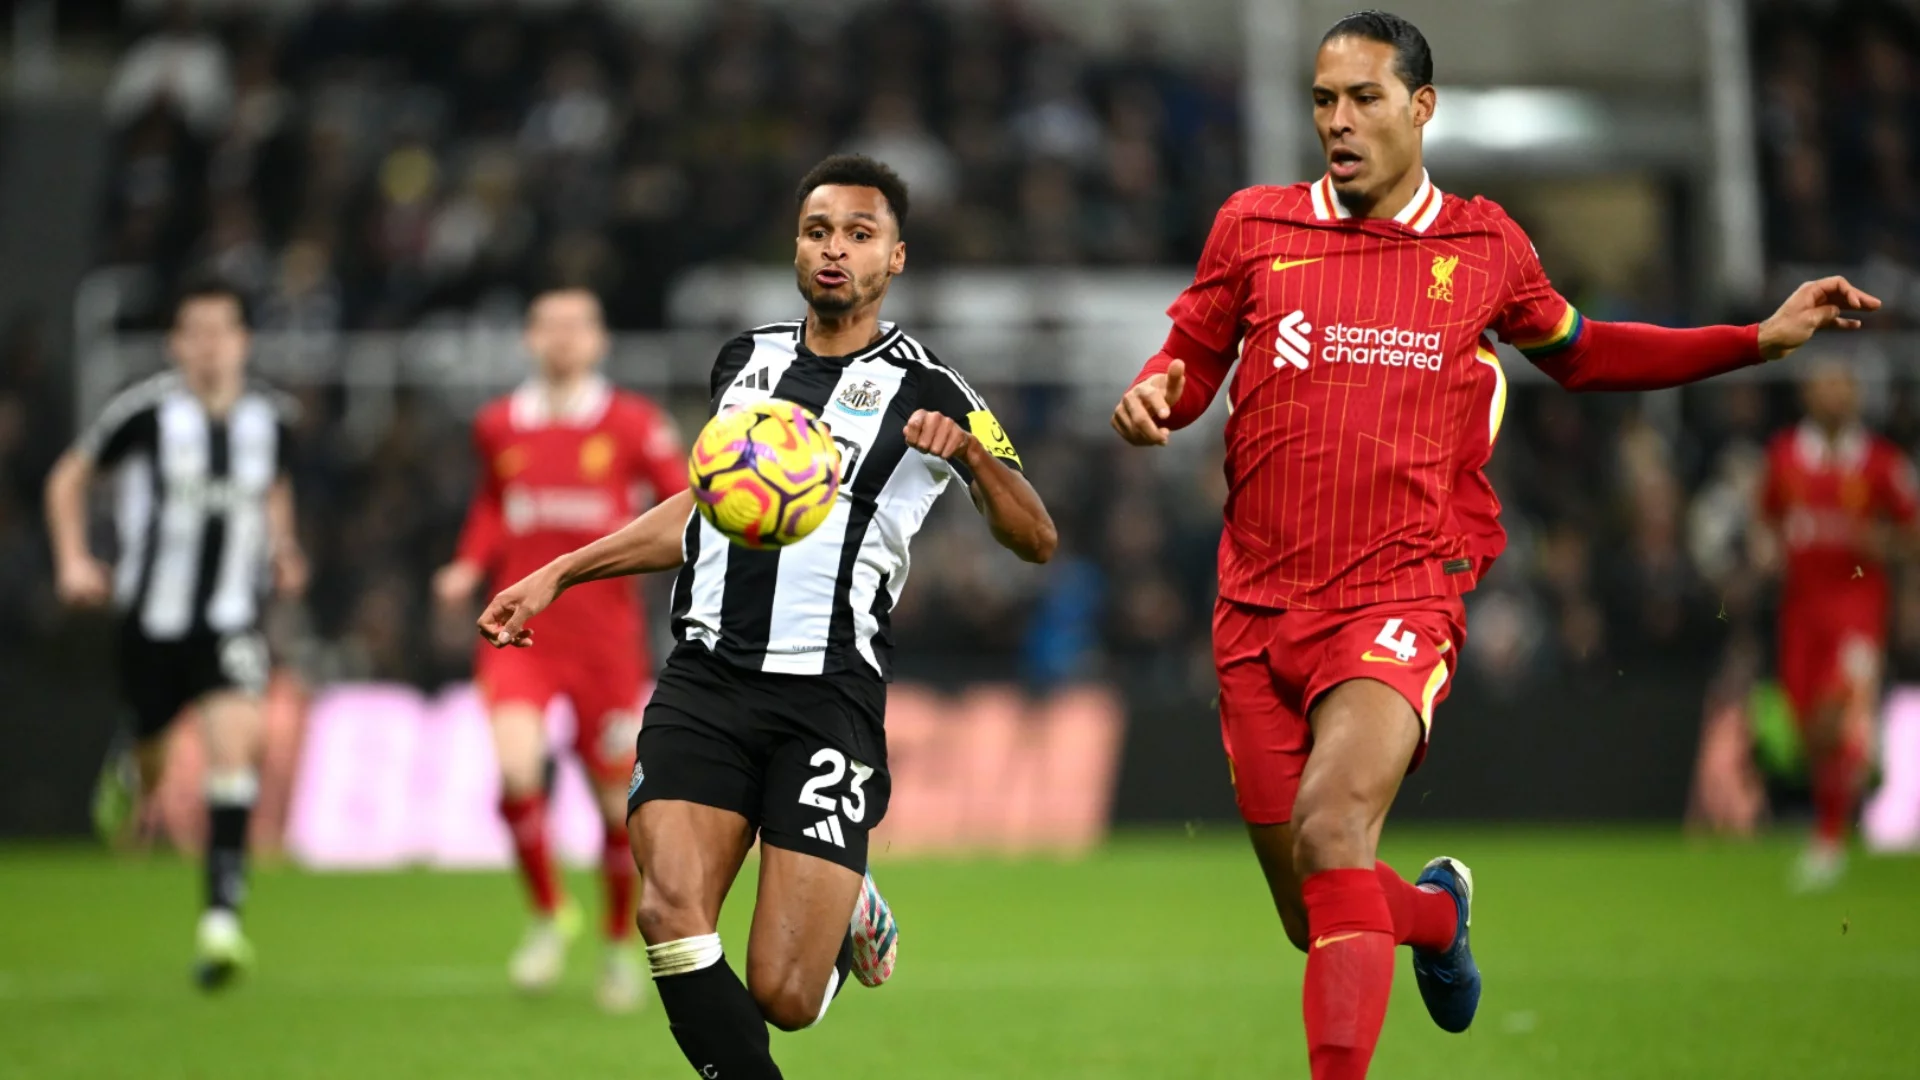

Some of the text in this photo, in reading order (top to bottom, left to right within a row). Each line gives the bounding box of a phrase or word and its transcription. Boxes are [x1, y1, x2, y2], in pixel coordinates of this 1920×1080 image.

[1324, 322, 1441, 350] standard
[1321, 343, 1443, 371] chartered
[1374, 618, 1418, 662] 4
[798, 747, 875, 823] 23
